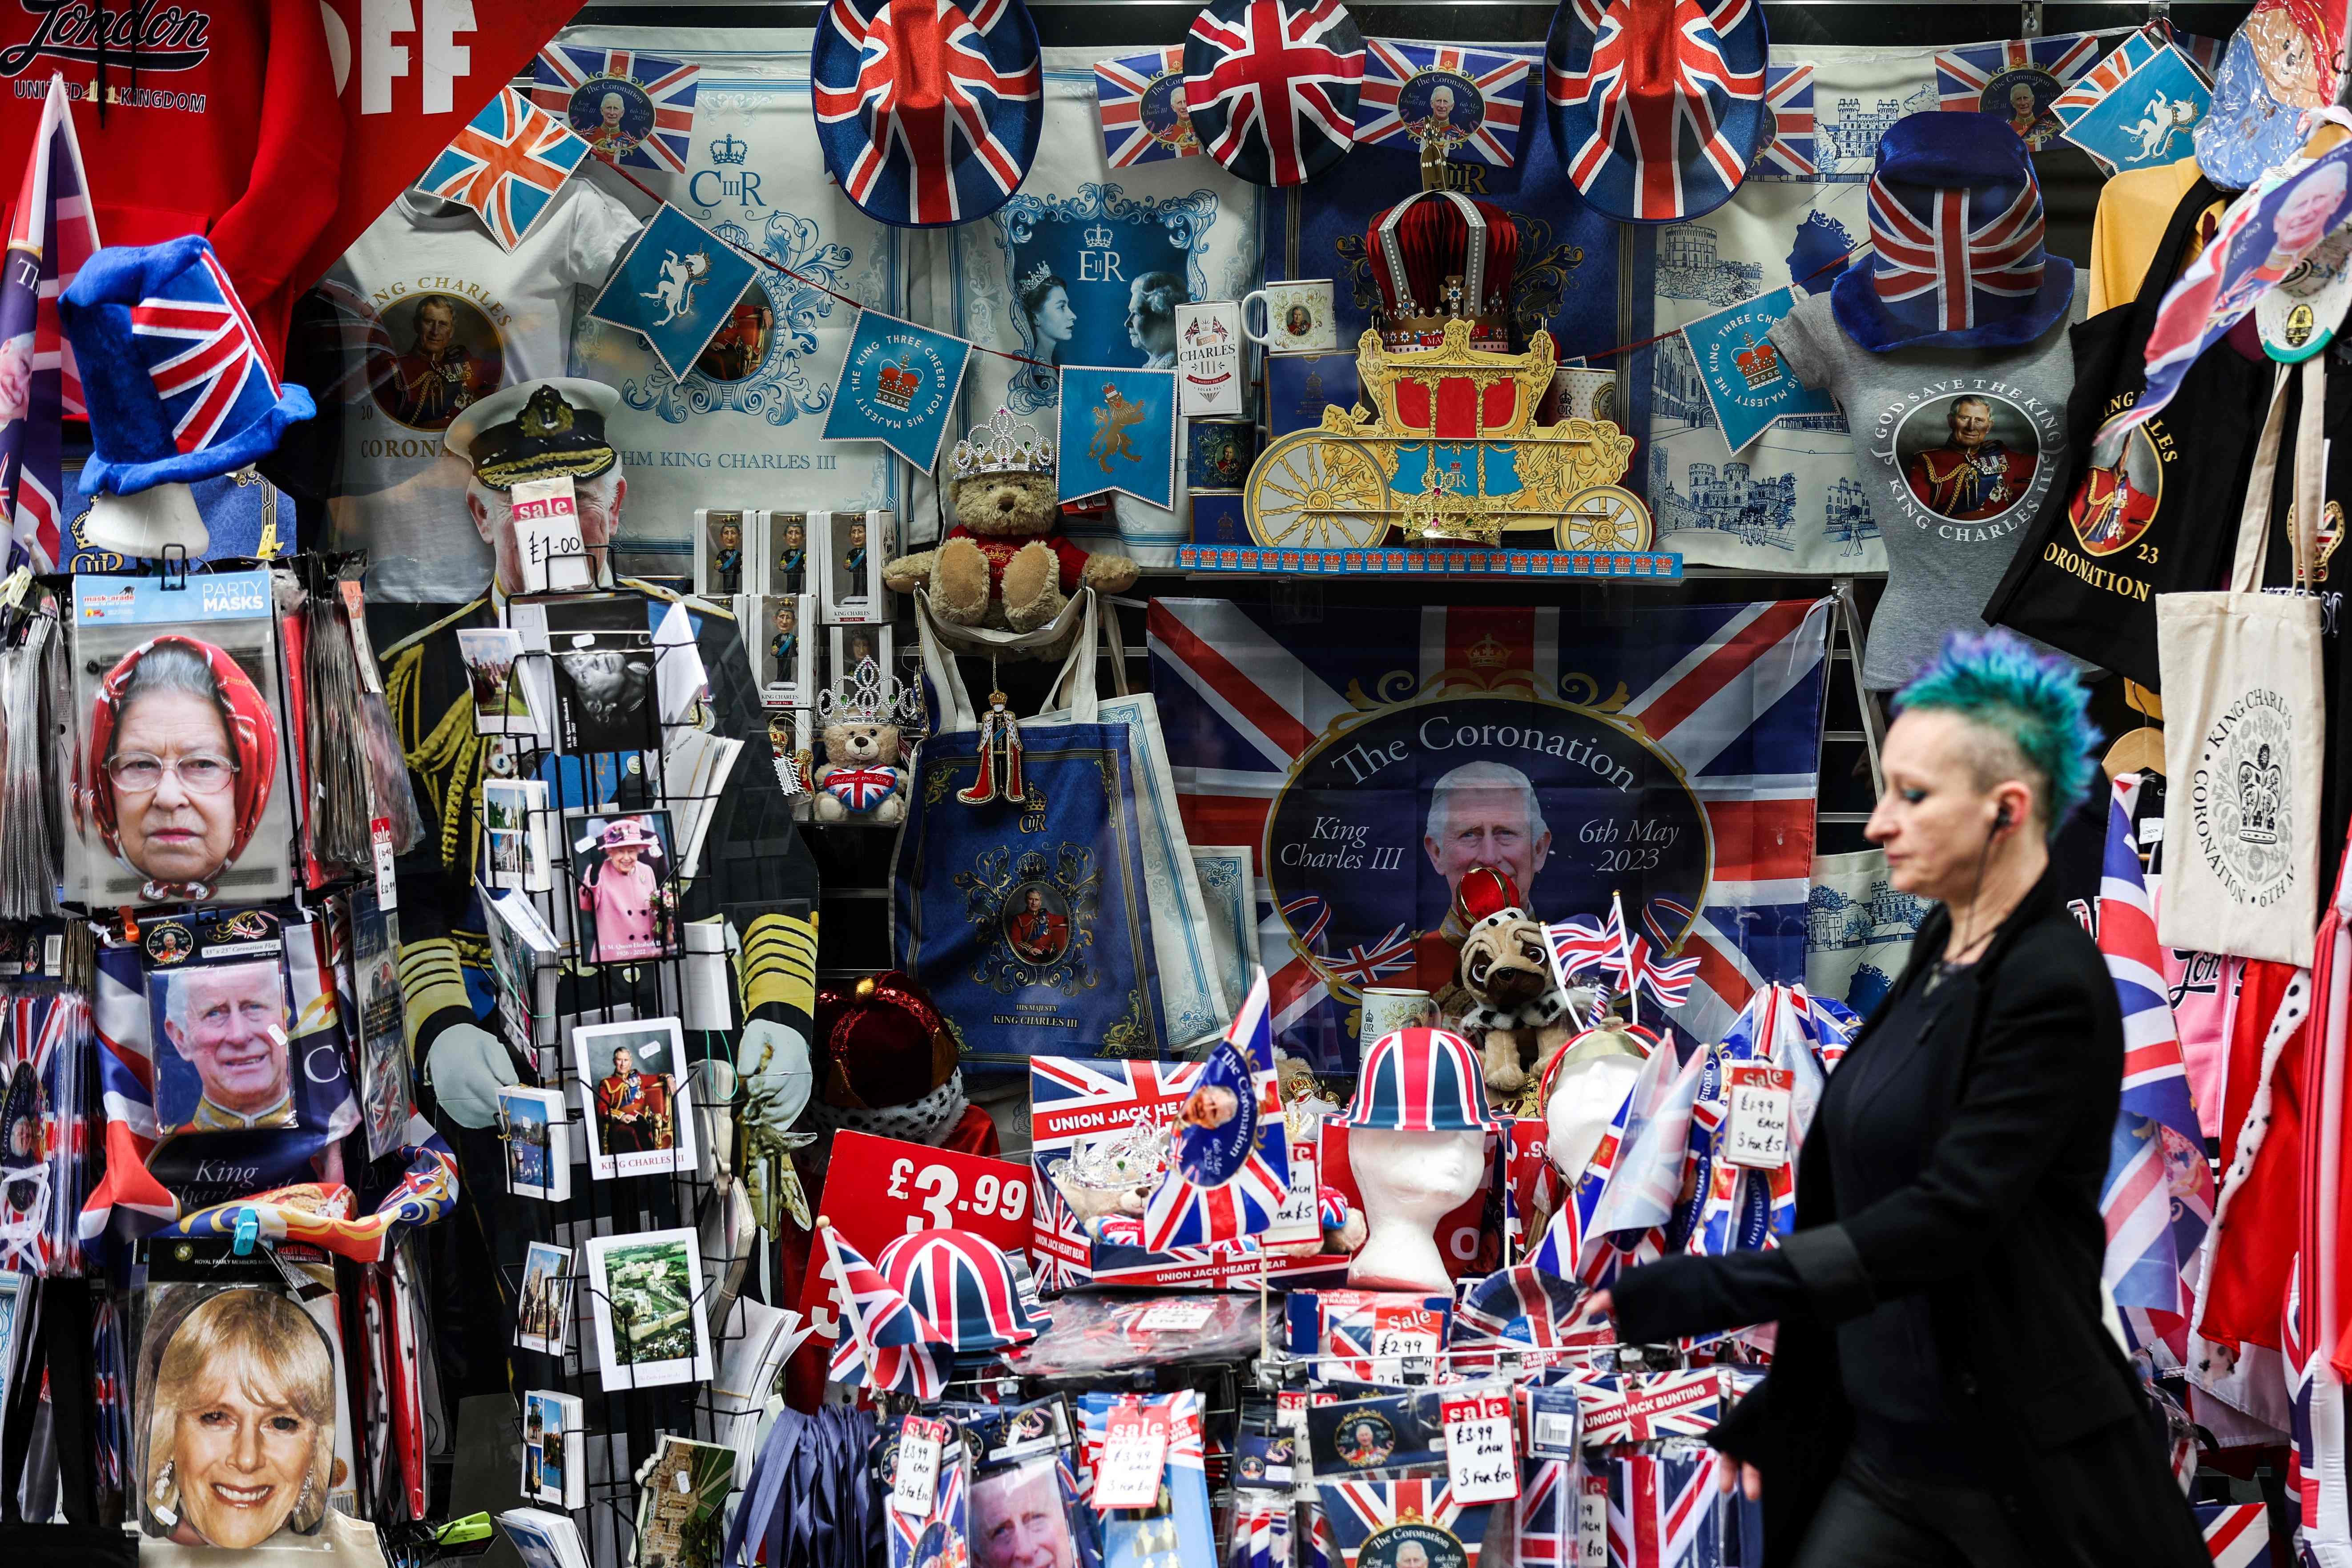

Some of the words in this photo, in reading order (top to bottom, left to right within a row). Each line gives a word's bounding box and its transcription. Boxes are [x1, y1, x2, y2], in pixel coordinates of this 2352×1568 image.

[584, 84, 600, 94] The
[602, 81, 643, 104] Coronation
[1149, 84, 1165, 97] The
[1414, 77, 1430, 88] The
[1432, 74, 1474, 97] Coronation
[1990, 81, 2006, 92] The
[2006, 73, 2050, 88] Coronation
[120, 87, 206, 113] KINGDOM
[418, 277, 512, 328] CHARLES
[1718, 313, 1752, 338] THREE
[858, 341, 880, 366] KING
[886, 335, 922, 350] THREE
[1180, 344, 1235, 362] CHARLES
[925, 347, 946, 389] CHEERS
[1200, 361, 1216, 374] III
[1709, 343, 1721, 373] KING
[851, 369, 861, 392] THE
[1713, 376, 1732, 397] THE
[926, 393, 942, 415] FOR
[1734, 390, 1788, 408] MAJESTY
[854, 397, 902, 429] MAJESTY
[906, 415, 925, 427] HIS
[1874, 401, 1906, 439] GOD
[1907, 379, 1965, 403] SAVE
[1973, 379, 2022, 399] THE
[2023, 394, 2063, 451] KING
[621, 451, 654, 467] HM
[660, 451, 712, 468] KING
[717, 453, 810, 470] CHARLES
[816, 455, 837, 470] III
[518, 498, 569, 521] sale
[1889, 476, 1931, 532] KING
[1937, 499, 2041, 543] CHARLES
[2136, 544, 2159, 564] 23
[83, 595, 135, 603] mask-arade
[202, 580, 262, 598] PARTY
[203, 596, 264, 613] MASKS
[2206, 700, 2246, 749] KING
[2245, 688, 2292, 731] CHARLES
[1330, 739, 1409, 785] The
[1419, 715, 1635, 793] Coronation
[784, 760, 797, 790] IMPORTANT
[830, 775, 843, 784] God
[874, 774, 890, 785] King
[373, 826, 391, 844] sale
[1310, 816, 1370, 849] King
[1579, 819, 1618, 843] 6th
[1624, 819, 1679, 848] May
[2192, 770, 2246, 905] CORONATION
[2259, 879, 2286, 907] 6TH
[1280, 842, 1374, 871] Charles
[1371, 847, 1406, 871] III
[1596, 847, 1660, 872] 2023
[232, 943, 263, 953] Coronation
[264, 941, 277, 951] Flag
[615, 942, 632, 951] Queen
[1029, 1004, 1058, 1013] MAJESTY
[993, 1015, 1018, 1024] KING
[1020, 1016, 1065, 1027] CHARLES
[1067, 1019, 1078, 1028] III
[1221, 1047, 1240, 1076] The
[1743, 1068, 1784, 1088] Sale
[2, 1086, 18, 1160] Coronation
[1048, 1112, 1105, 1132] UNION
[1108, 1105, 1153, 1125] JACK
[1229, 1076, 1250, 1157] Coronation
[1757, 1117, 1784, 1129] EACH
[1737, 1131, 1745, 1147] 3
[1748, 1137, 1761, 1150] FOR
[1765, 1134, 1783, 1153] £5
[628, 1156, 671, 1168] CHARLES
[193, 1159, 259, 1189] King
[886, 1158, 1027, 1234] £3.99
[1296, 1201, 1313, 1220] £5
[1035, 1232, 1047, 1248] UNION
[1047, 1237, 1059, 1252] JACK
[1059, 1242, 1072, 1258] HEART
[1072, 1246, 1085, 1262] BEAR
[1156, 1270, 1191, 1282] UNION
[1192, 1267, 1220, 1279] JACK
[1222, 1262, 1257, 1275] HEART
[1331, 1298, 1360, 1307] NAPKINS
[1387, 1310, 1431, 1331] Sale
[1379, 1333, 1422, 1356] £2.99
[1448, 1398, 1504, 1423] sale
[1585, 1408, 1622, 1428] UNION
[1623, 1399, 1655, 1417] JACK
[1655, 1384, 1706, 1409] BUNTING
[1112, 1418, 1164, 1438] sale
[1457, 1425, 1493, 1444] £3.99
[913, 1463, 930, 1474] EACH
[1459, 1467, 1469, 1486] 3
[1474, 1471, 1492, 1484] FOR
[1494, 1463, 1511, 1483] £10
[899, 1479, 905, 1496] 3
[1107, 1479, 1115, 1491] 3
[1371, 1534, 1391, 1550] The
[1392, 1528, 1450, 1550] Coronation
[1587, 1540, 1603, 1557] £10
